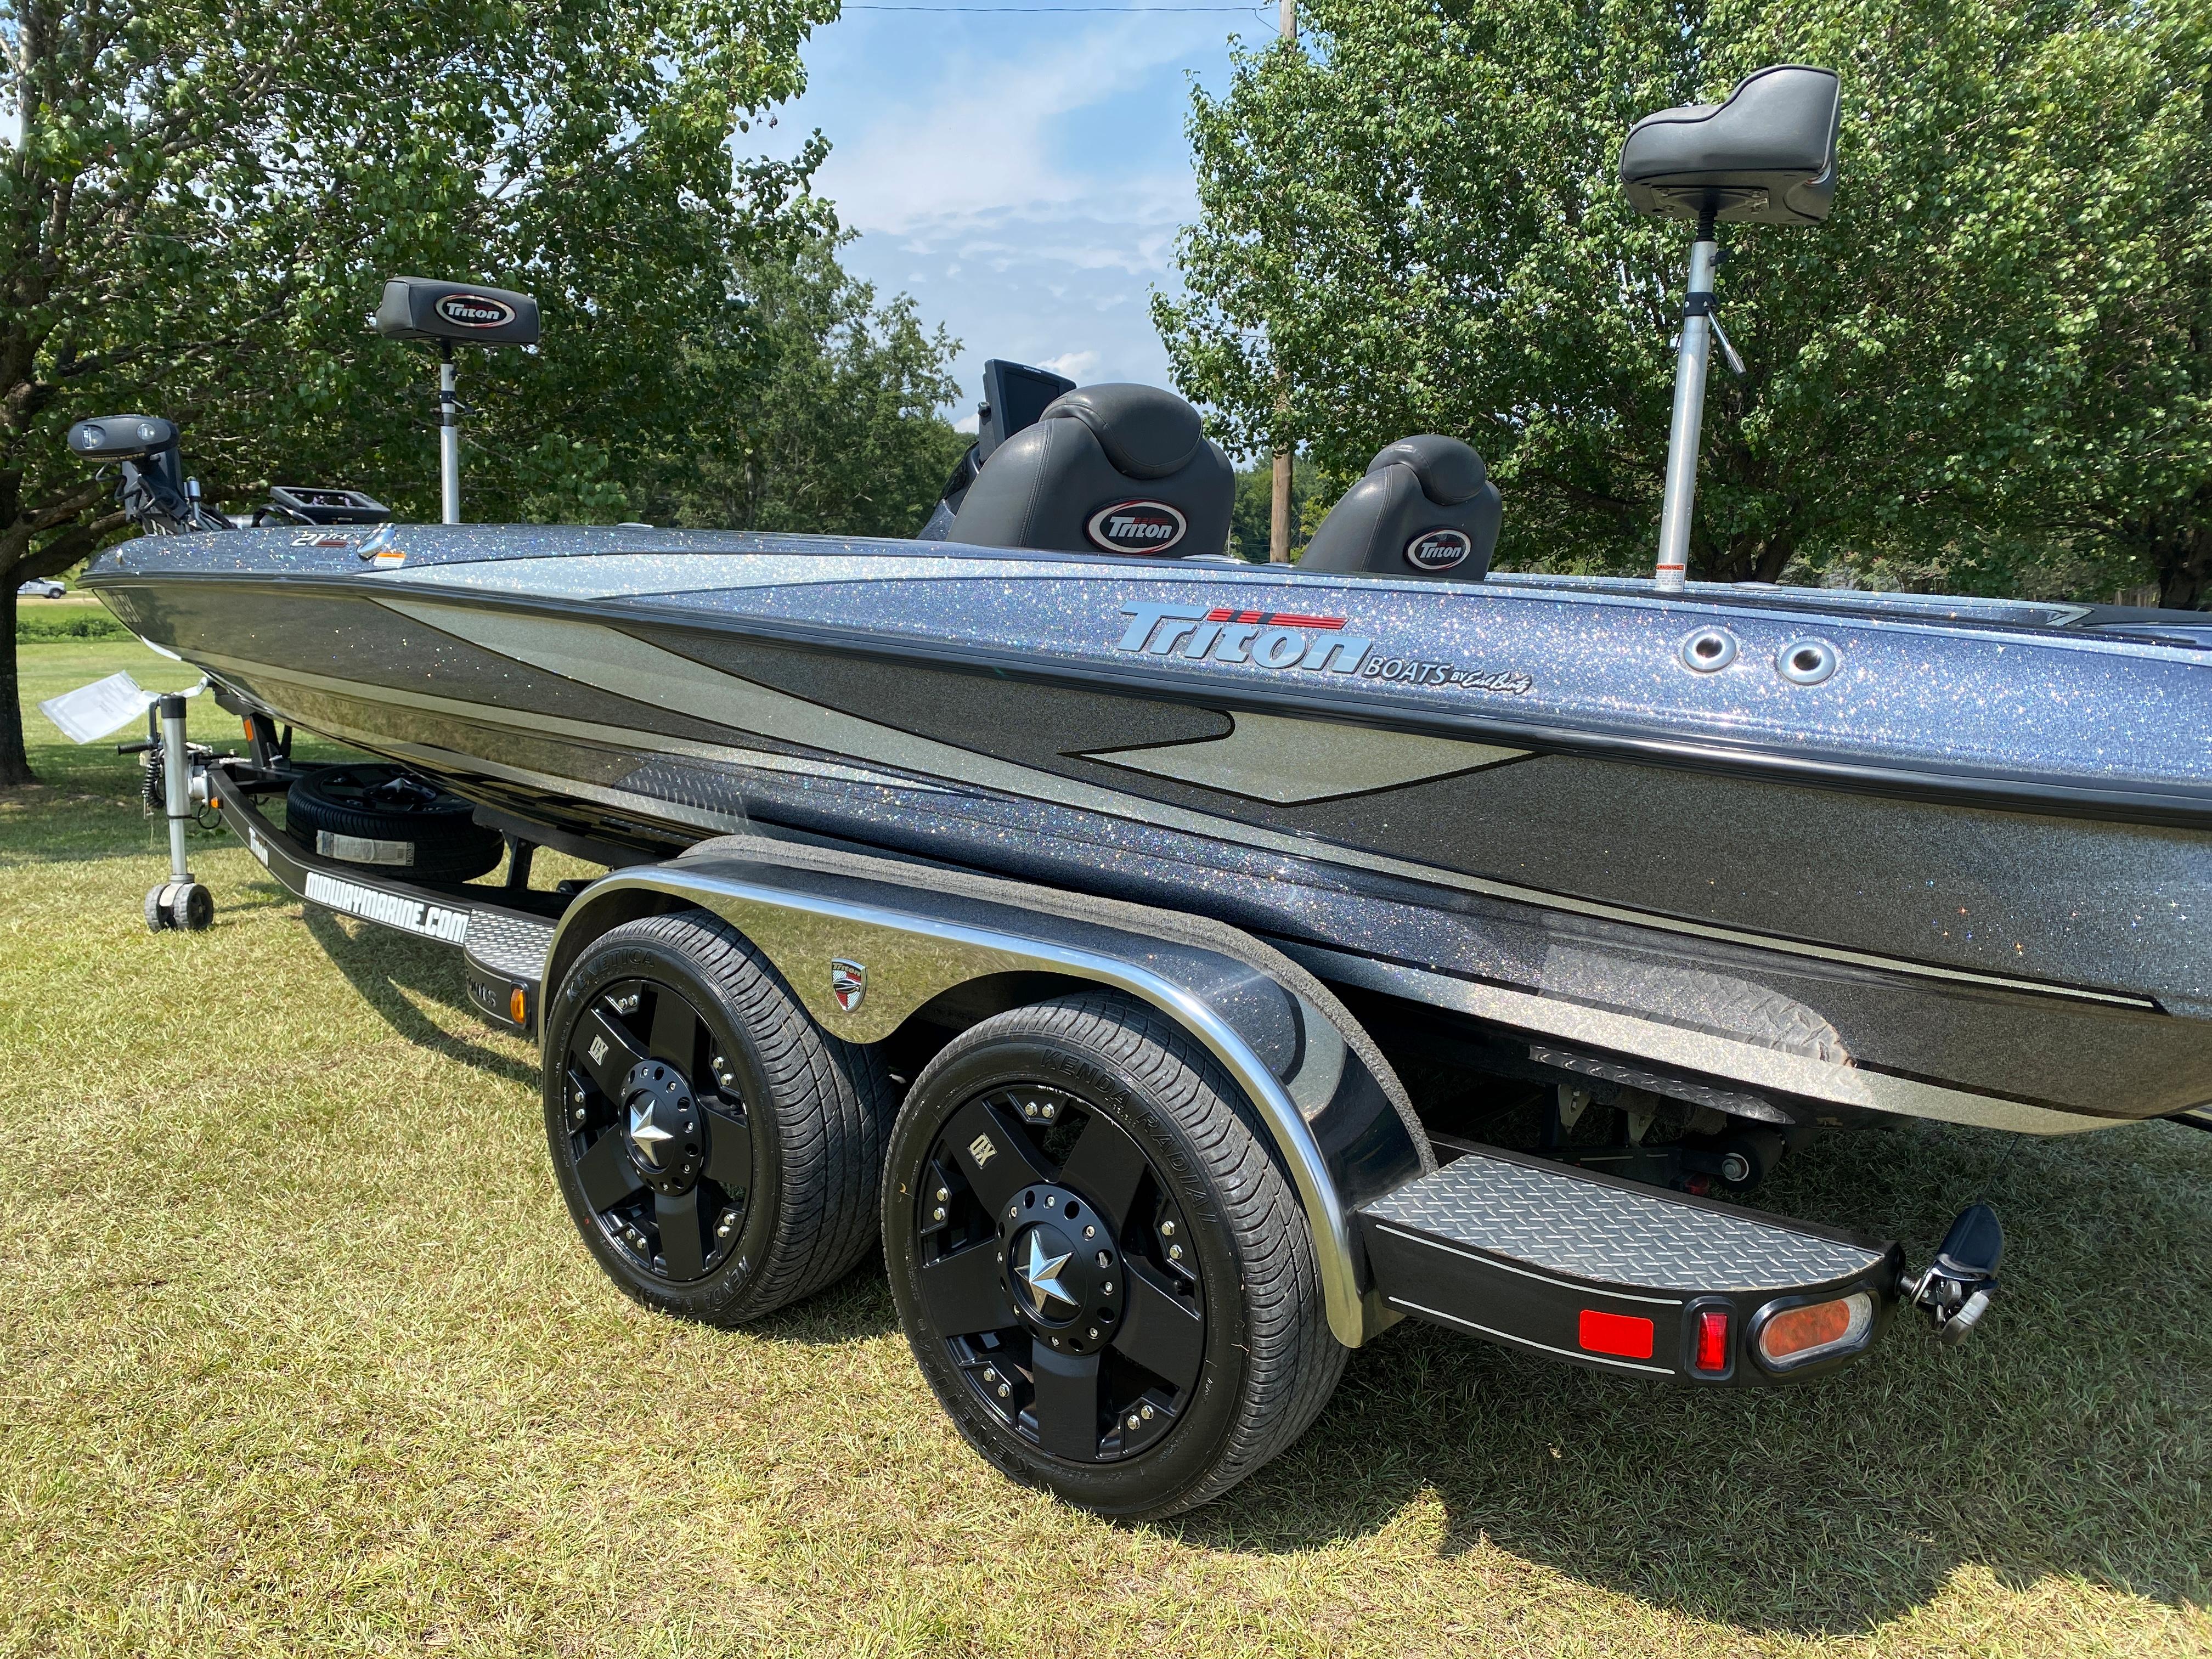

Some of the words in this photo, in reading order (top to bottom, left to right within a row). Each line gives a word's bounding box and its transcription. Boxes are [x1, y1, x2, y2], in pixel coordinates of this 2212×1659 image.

[447, 302, 500, 320] Triton
[290, 533, 326, 548] 21
[1108, 516, 1172, 539] Triton
[1419, 542, 1462, 558] Triton
[1117, 600, 1373, 675] Triton
[1363, 656, 1451, 685] BOATS
[1450, 671, 1469, 681] BY
[249, 826, 268, 868] Triton
[304, 871, 469, 944] MIDWAYMARINE.COM
[832, 963, 861, 977] Triton
[1041, 1048, 1132, 1105] KENDA
[1135, 1110, 1218, 1231] RADIAL
[703, 1255, 751, 1310] KENDA
[916, 1332, 1036, 1486] KENETICA
